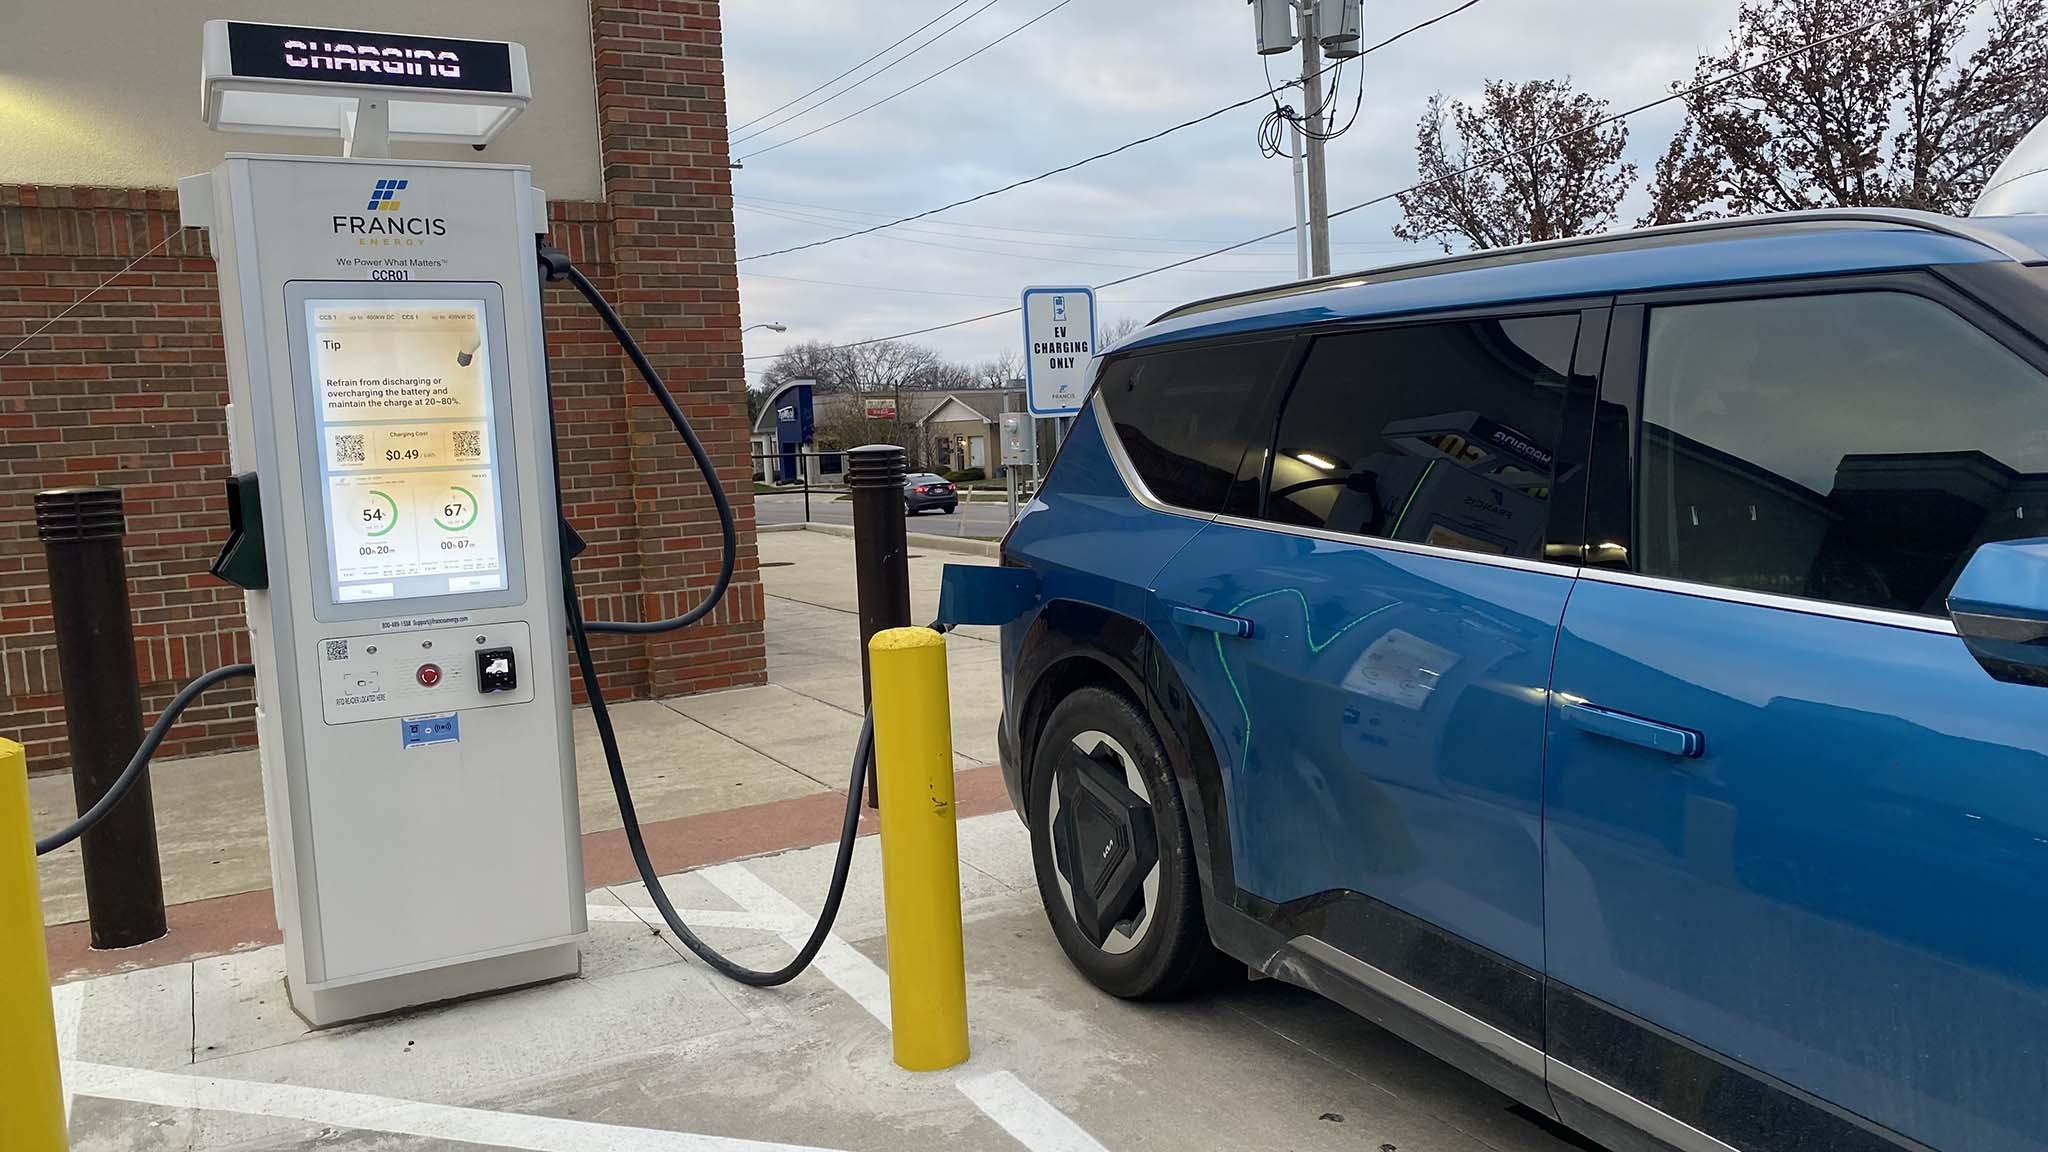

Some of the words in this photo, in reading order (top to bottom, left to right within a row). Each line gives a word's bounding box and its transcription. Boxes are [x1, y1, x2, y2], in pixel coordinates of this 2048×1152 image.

[284, 40, 461, 78] CHARGING
[333, 216, 447, 236] FRANCIS
[359, 238, 425, 246] ENERGY
[336, 258, 352, 266] We
[354, 258, 382, 267] Power
[384, 258, 408, 267] What
[372, 270, 409, 281] CCR01
[1054, 326, 1067, 338] EV
[323, 340, 342, 351] Tip
[1034, 341, 1089, 355] CHARGING
[1049, 357, 1075, 369] ONLY
[326, 379, 358, 387] Refrain
[360, 378, 380, 386] from
[382, 377, 432, 387] discharging
[327, 389, 384, 398] overcharging
[385, 388, 400, 396] the
[401, 387, 431, 397] battery
[432, 387, 448, 395] and
[328, 400, 366, 408] maintain
[368, 399, 382, 407] the
[383, 398, 413, 408] charge
[414, 398, 423, 406] at
[389, 430, 415, 438] Charging
[386, 449, 419, 461] $0.49
